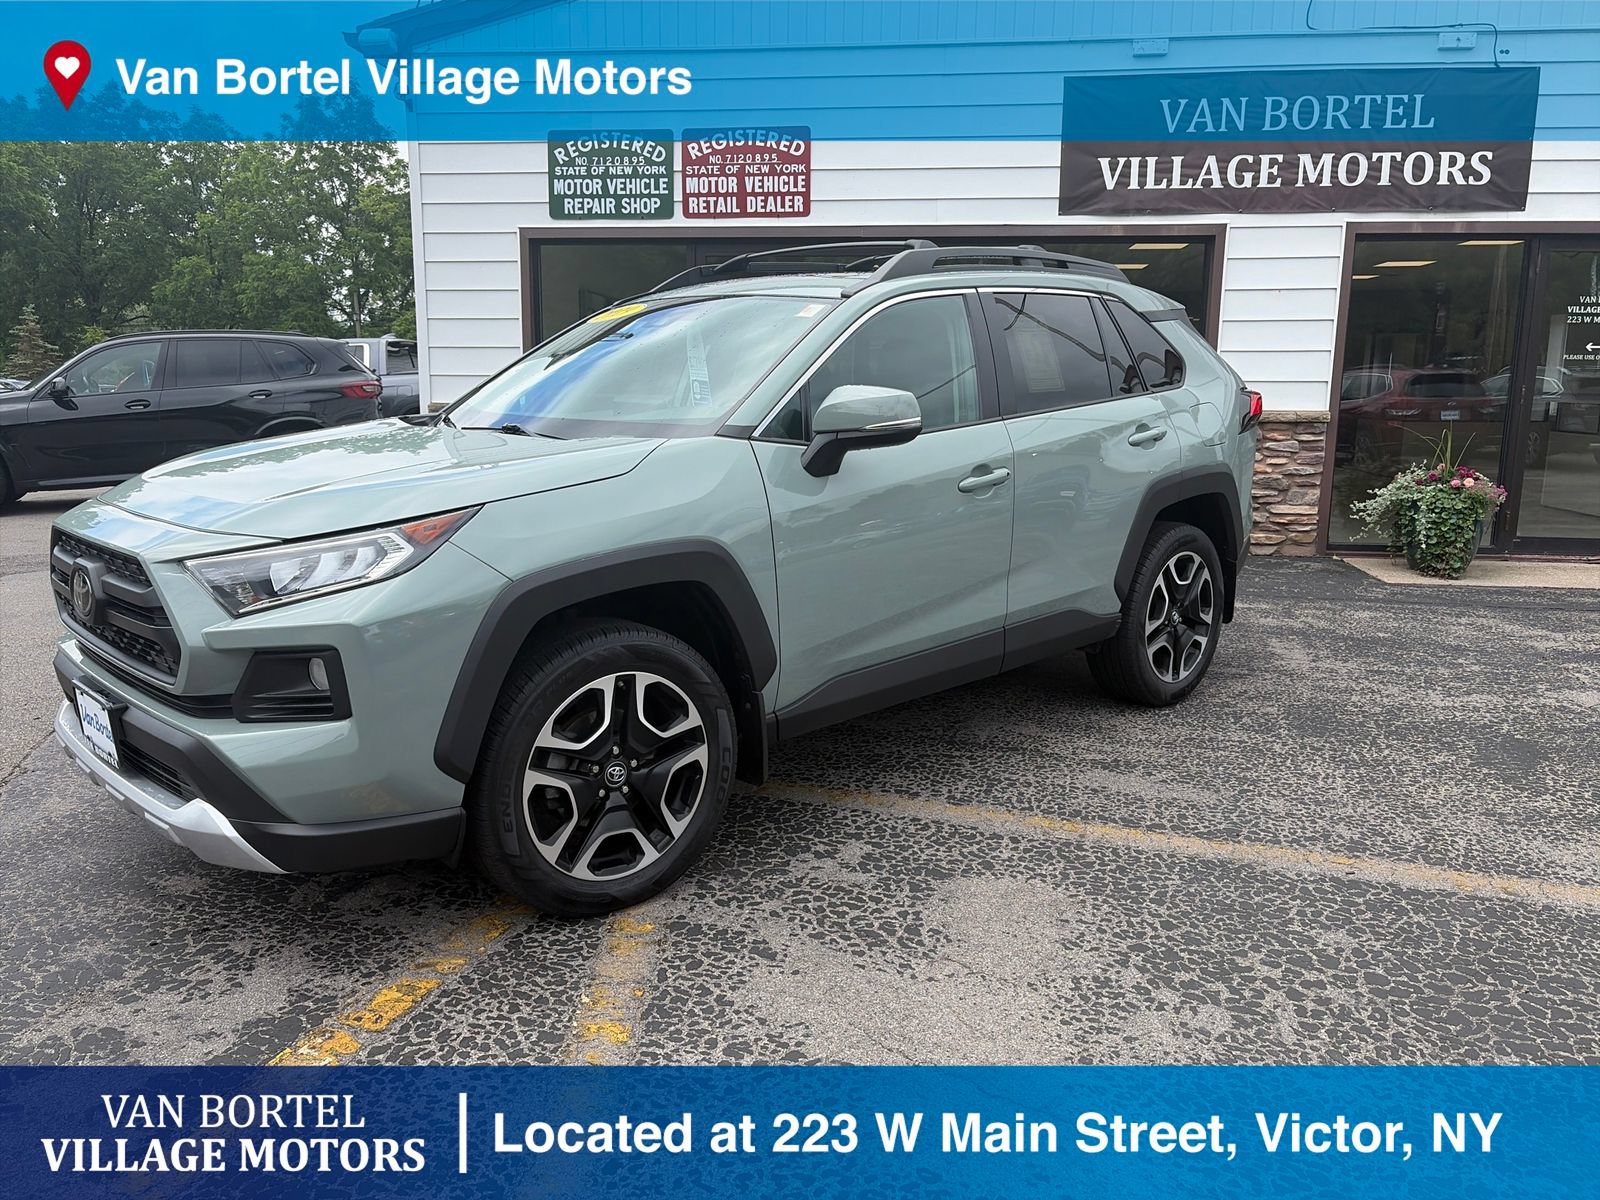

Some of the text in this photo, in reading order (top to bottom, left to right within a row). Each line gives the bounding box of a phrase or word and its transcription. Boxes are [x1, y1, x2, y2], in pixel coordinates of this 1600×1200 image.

[1160, 94, 1435, 133] VAN BORTEL
[553, 132, 666, 164] REGISTERED
[686, 129, 806, 160] REGISTERED
[575, 156, 645, 166] NO. 7120895
[709, 153, 778, 164] NO. 7120895
[555, 165, 666, 176] STATE OF NEW YORK
[686, 164, 806, 175] STATE OF NEW YORK
[1098, 151, 1494, 190] VILLAGE MOTORS
[553, 178, 669, 195] MOTOR VEHICLE
[685, 175, 806, 193] MOTOR VEHICLE
[564, 197, 661, 214] REPAIR SHOP
[688, 196, 804, 213] RETAIL DEALER
[1579, 295, 1597, 303] VAN
[1567, 315, 1582, 324] 223
[1584, 316, 1593, 324] W
